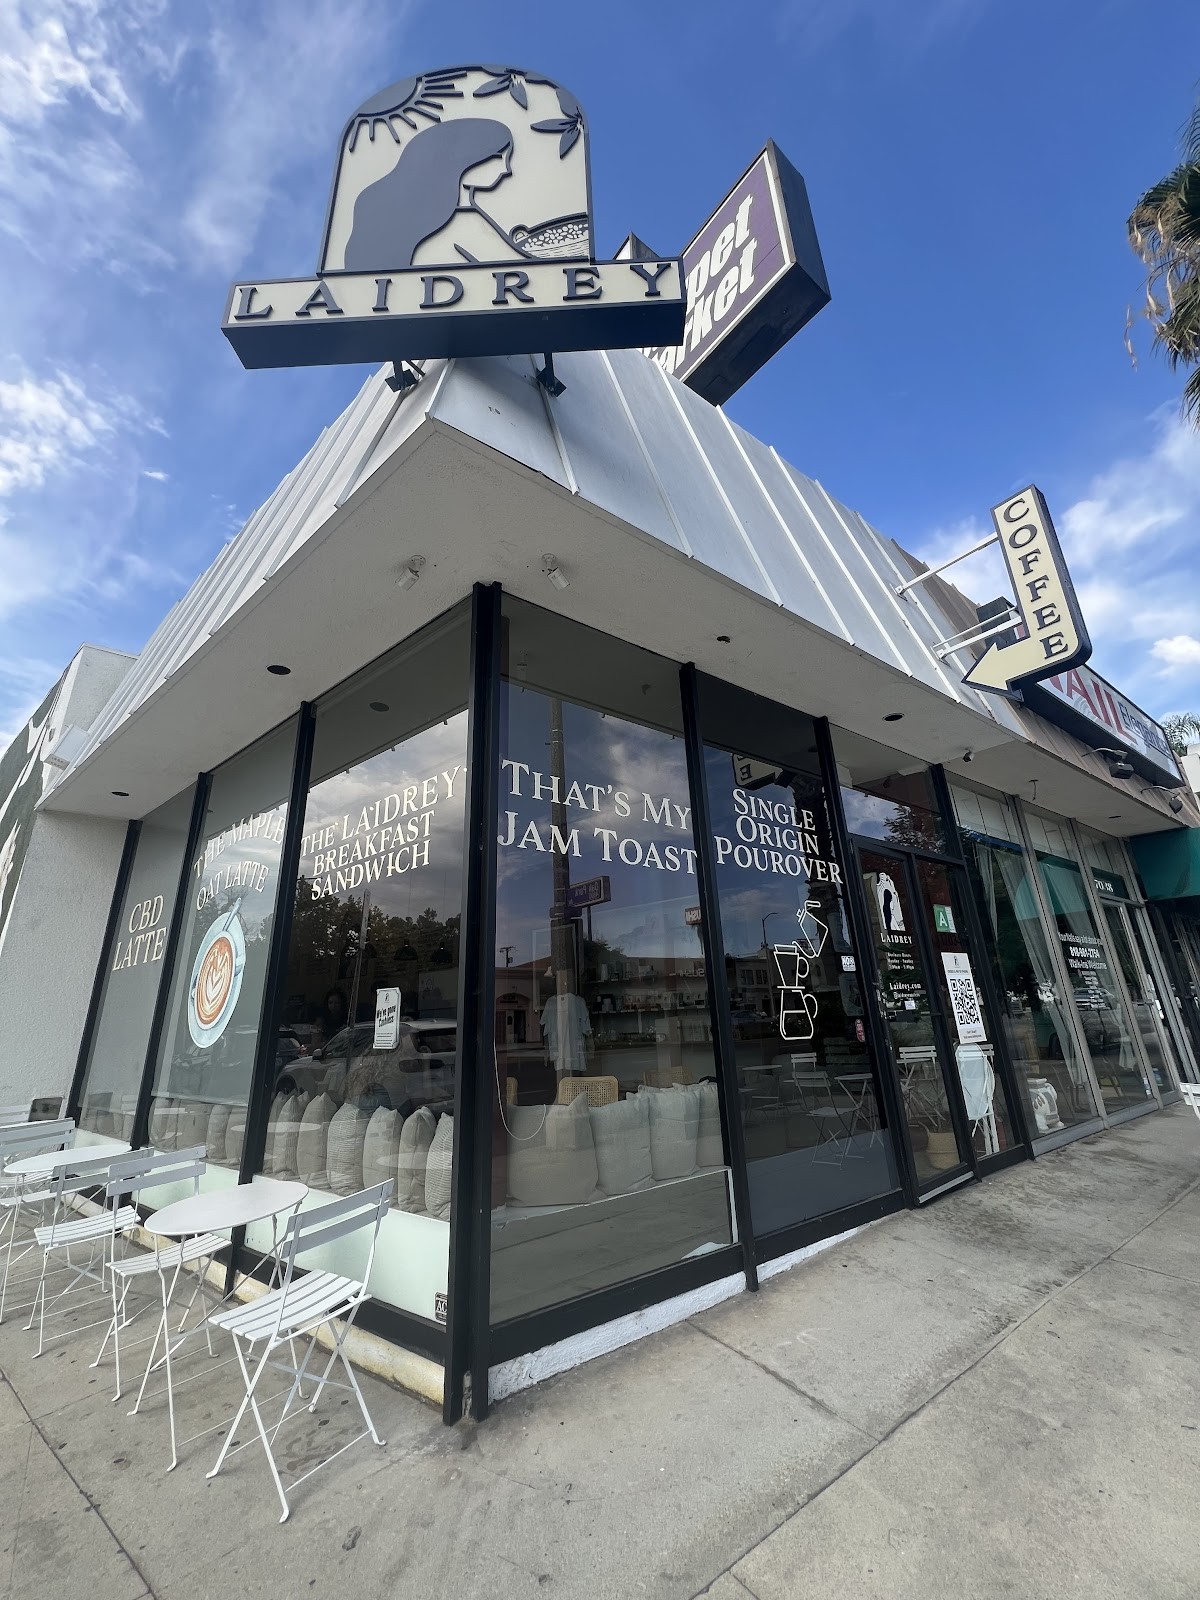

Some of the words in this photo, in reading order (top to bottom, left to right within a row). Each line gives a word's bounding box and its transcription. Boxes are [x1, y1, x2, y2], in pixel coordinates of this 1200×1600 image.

[685, 193, 753, 314] pet
[234, 264, 674, 320] LAIDREY
[643, 237, 757, 375] arket
[1003, 498, 1068, 659] COFFEE
[301, 824, 336, 857] THE
[341, 765, 461, 841] LAIDREY
[501, 759, 631, 817] THAT'S
[641, 792, 691, 830] MY
[733, 788, 816, 831] SINGLE
[194, 831, 226, 879] THE
[229, 812, 286, 844] MAPLE
[313, 810, 435, 877] BREAKFAST
[497, 810, 582, 858] JAM
[593, 827, 697, 874] TOAST
[714, 835, 843, 884] POUROVER
[736, 815, 819, 856] ORIGIN
[196, 870, 223, 910] OAT
[224, 861, 269, 893] LATTE
[311, 839, 431, 901] SANDWICH
[128, 895, 164, 933] CBD
[880, 932, 912, 944] LAIDREY
[940, 911, 948, 927] A
[112, 927, 167, 971] LATTE
